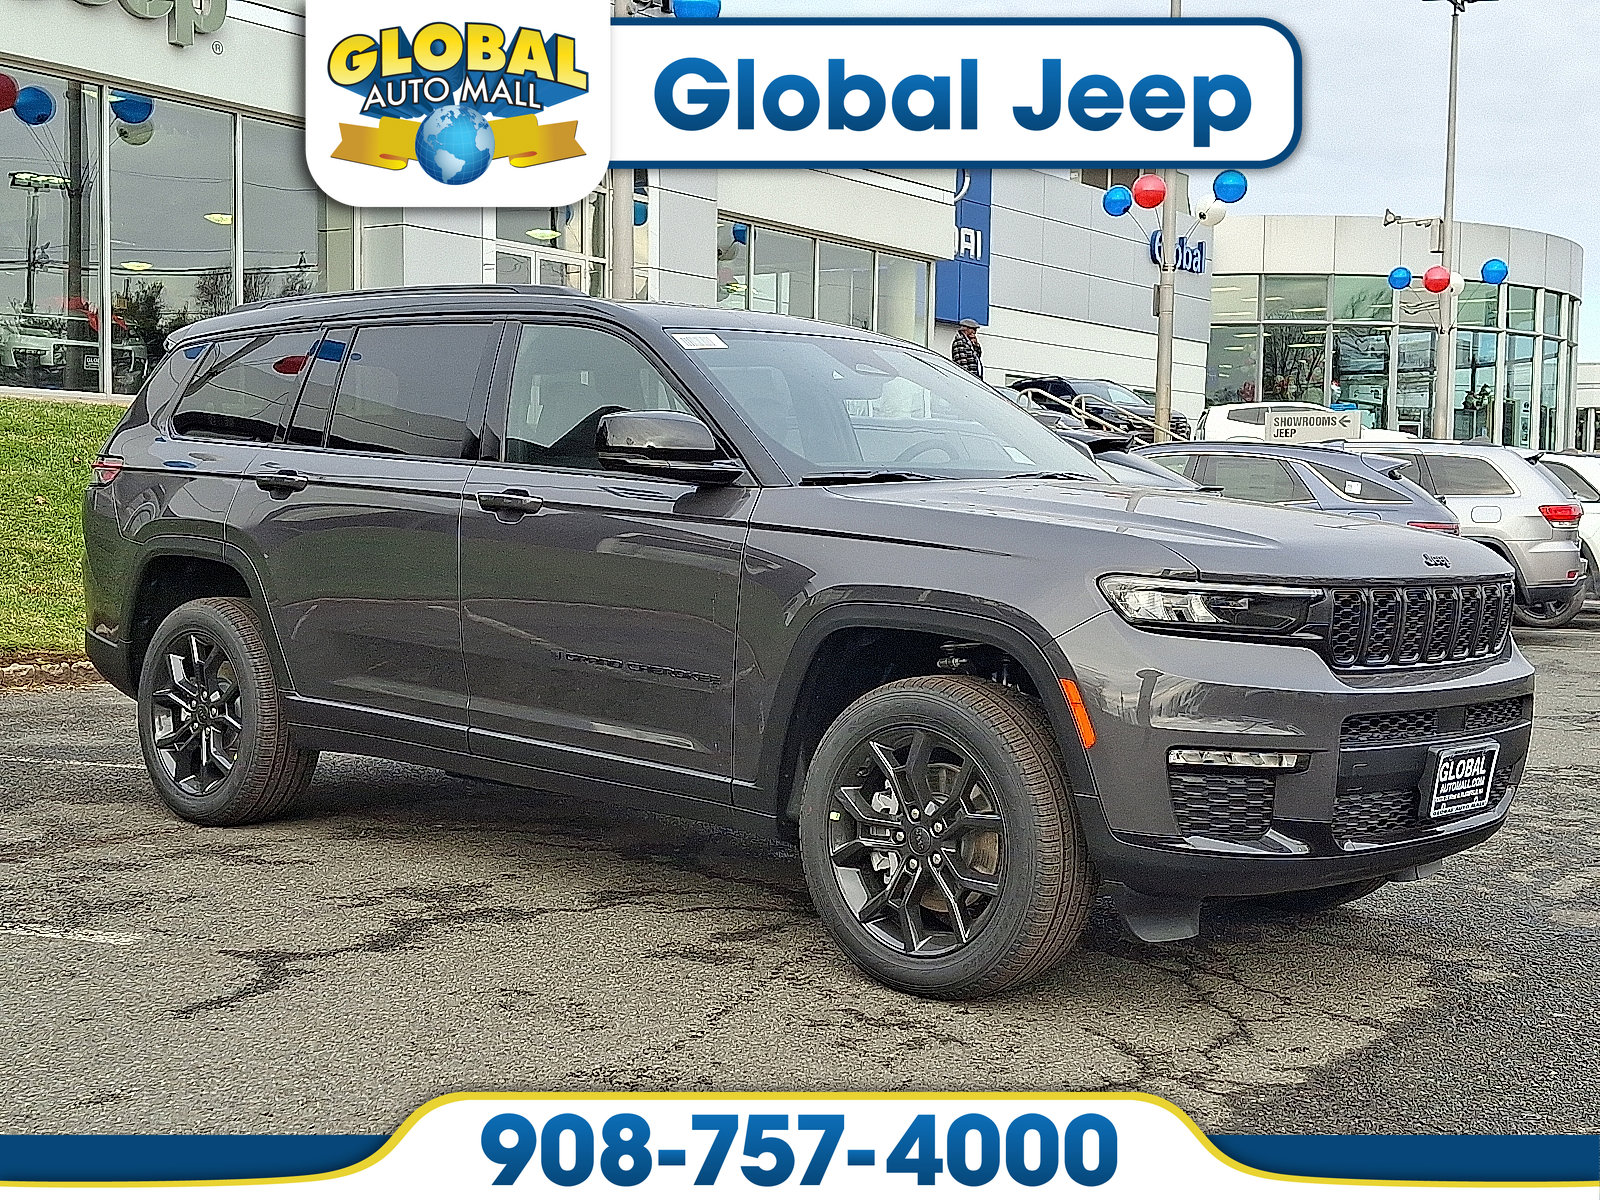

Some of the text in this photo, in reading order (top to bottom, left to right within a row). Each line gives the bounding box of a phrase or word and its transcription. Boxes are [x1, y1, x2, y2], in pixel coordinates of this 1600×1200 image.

[1273, 416, 1337, 427] SHOWROOMS
[1273, 428, 1297, 438] JEEP
[1422, 553, 1451, 569] Jeep
[1440, 756, 1486, 782] GLOBAL
